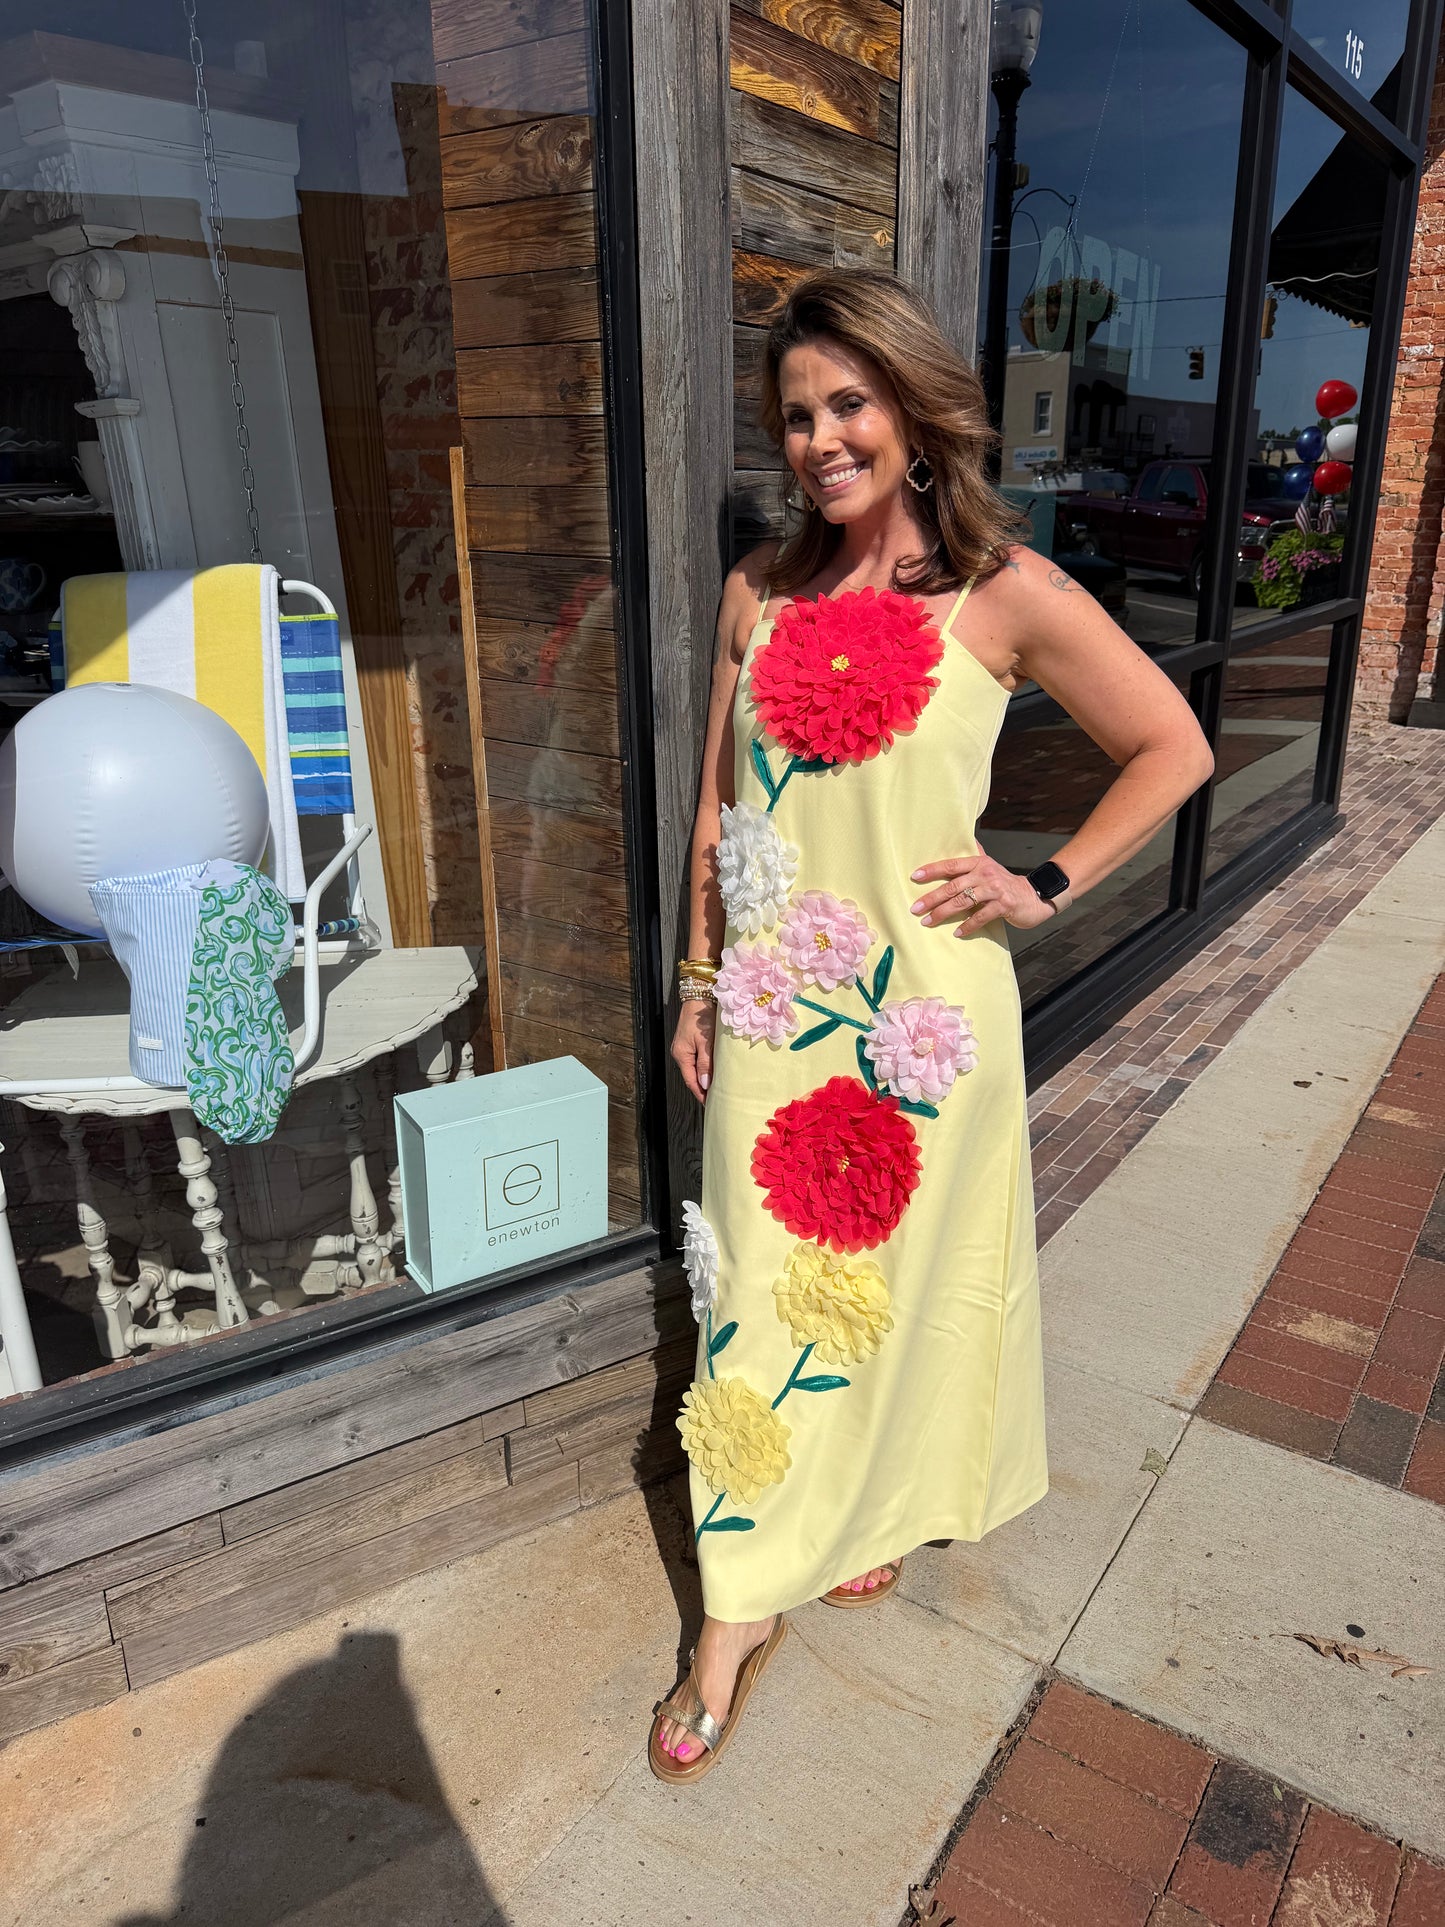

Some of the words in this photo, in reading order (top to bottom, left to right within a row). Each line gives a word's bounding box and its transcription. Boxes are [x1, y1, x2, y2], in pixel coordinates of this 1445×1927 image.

[1345, 29, 1364, 80] 115
[1033, 225, 1162, 381] OPEN
[503, 1163, 542, 1206] e
[487, 1216, 560, 1247] enewton
